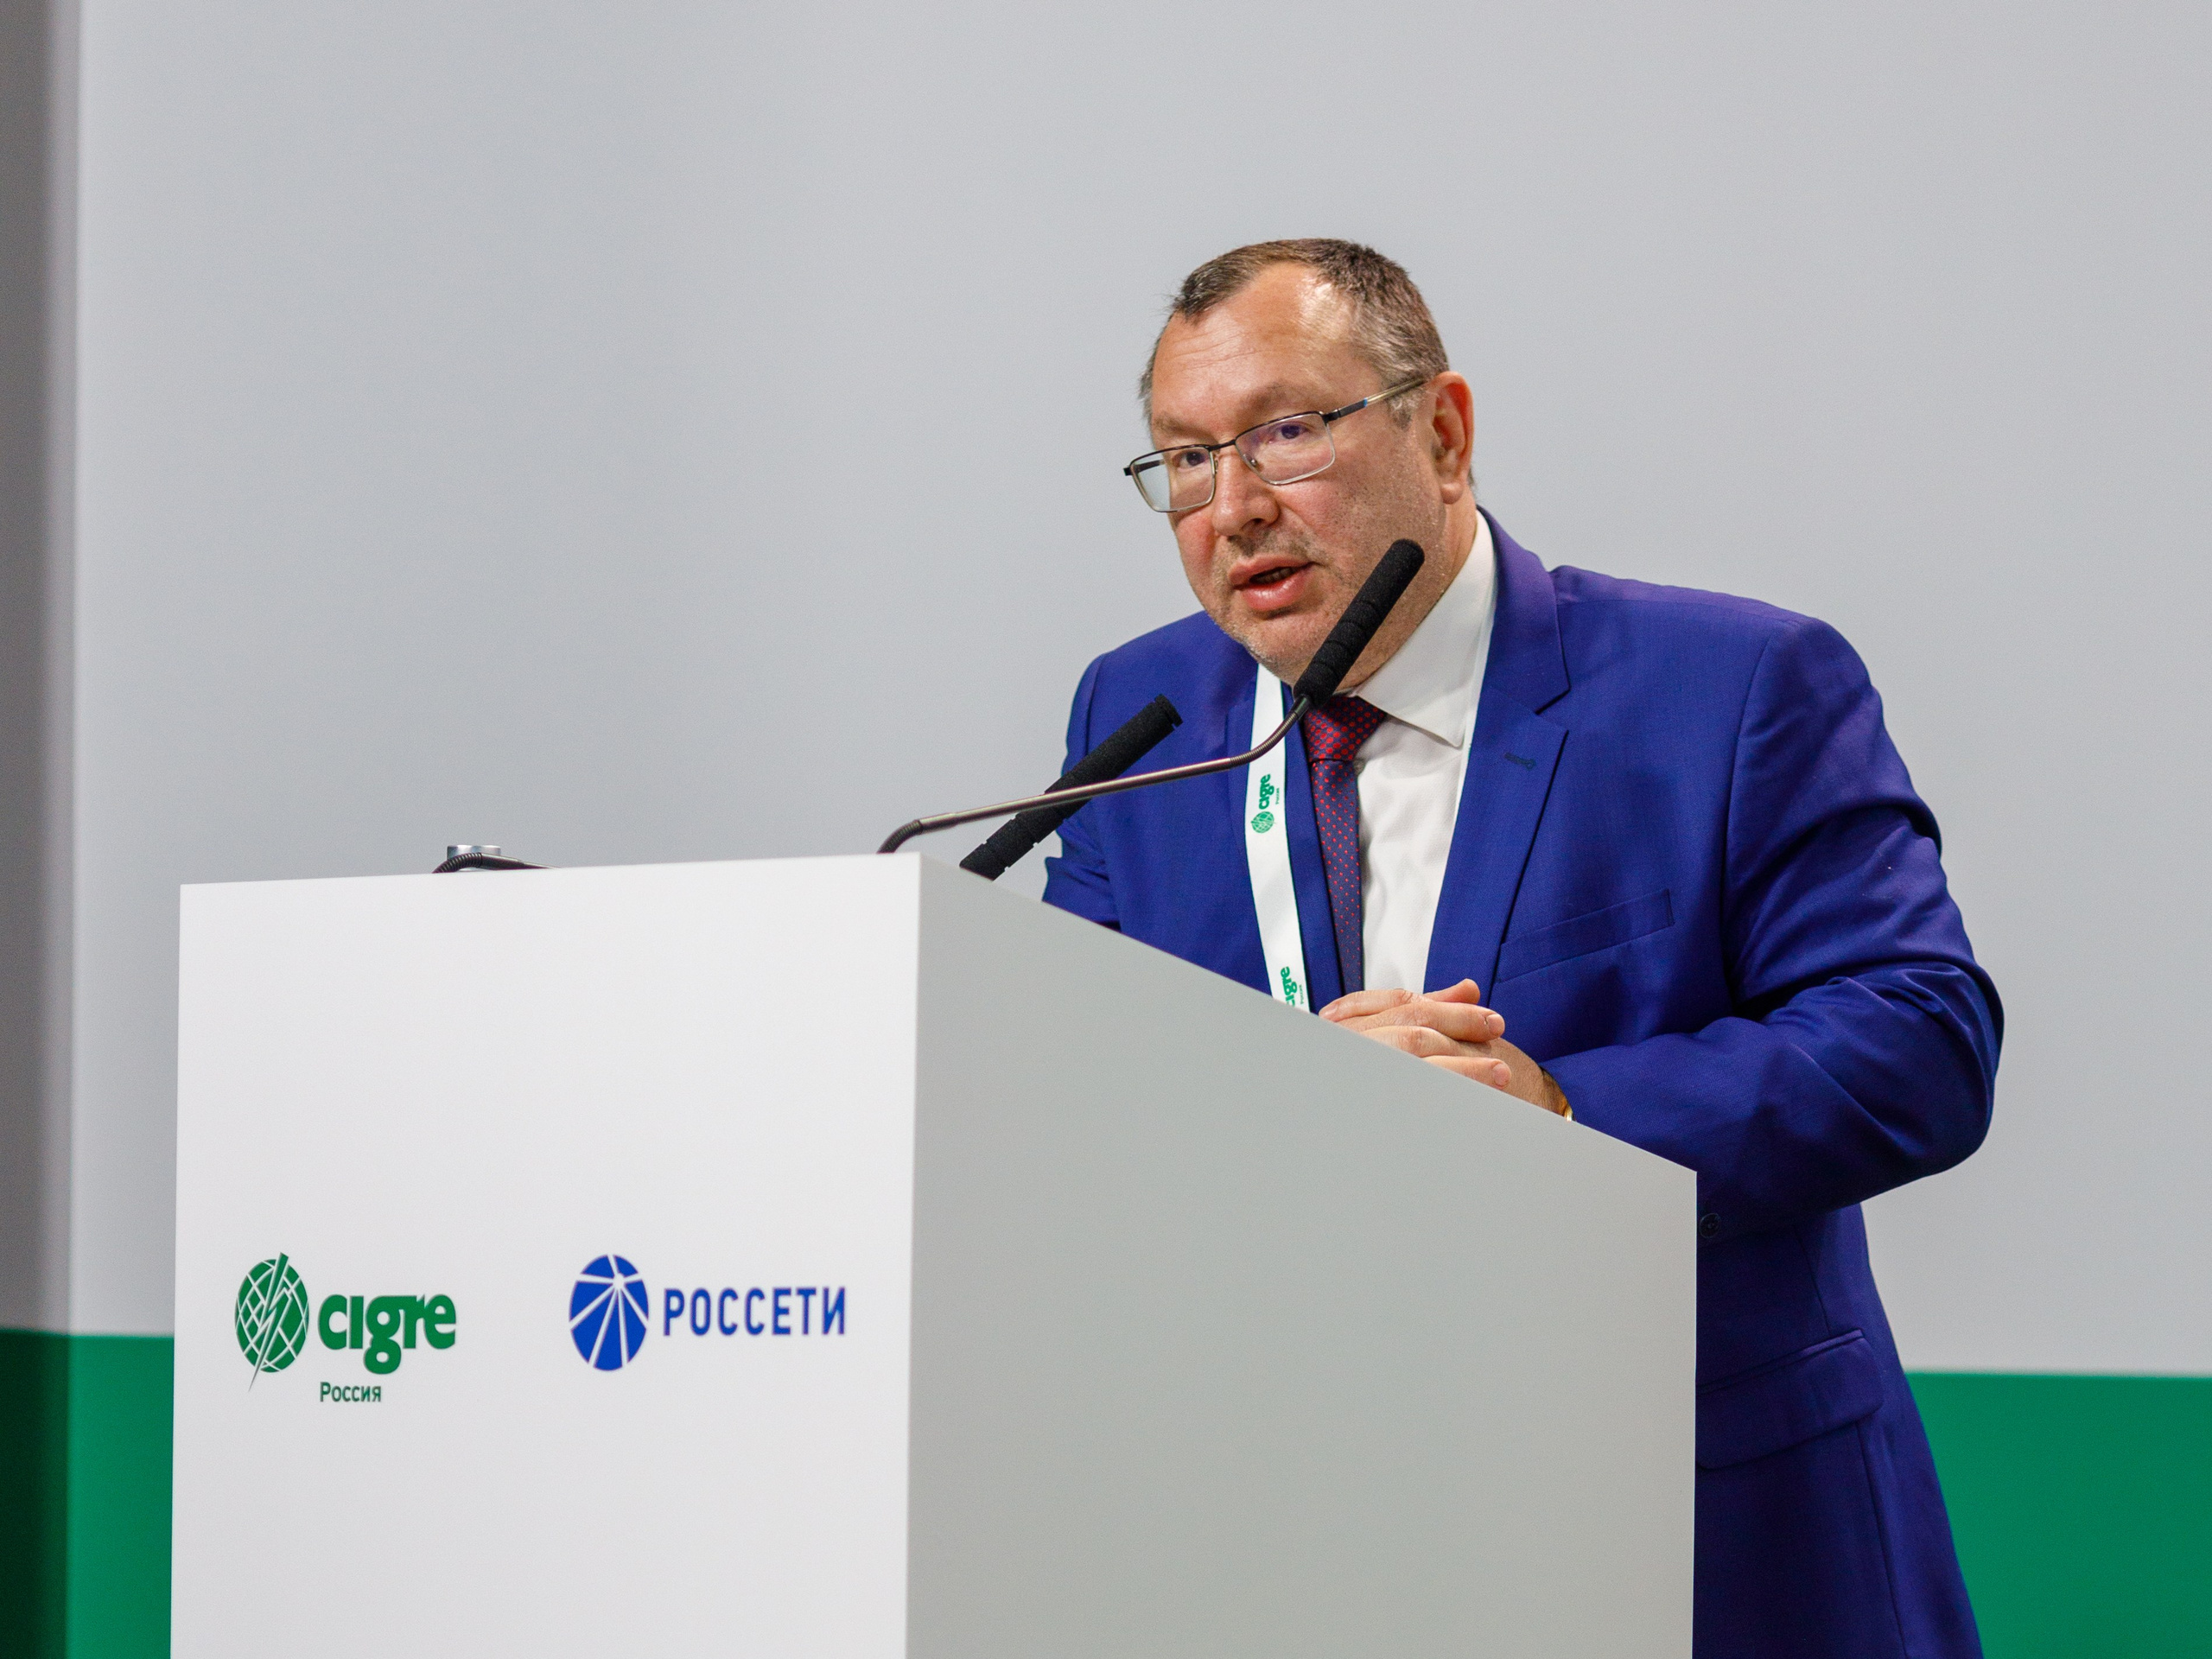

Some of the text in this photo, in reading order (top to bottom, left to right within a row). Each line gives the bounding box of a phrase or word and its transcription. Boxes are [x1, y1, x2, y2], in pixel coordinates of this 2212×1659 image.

[1259, 774, 1274, 810] cigre
[663, 1287, 846, 1337] РОССЕТИ
[319, 1294, 456, 1375] cigre
[321, 1382, 381, 1402] Россия
